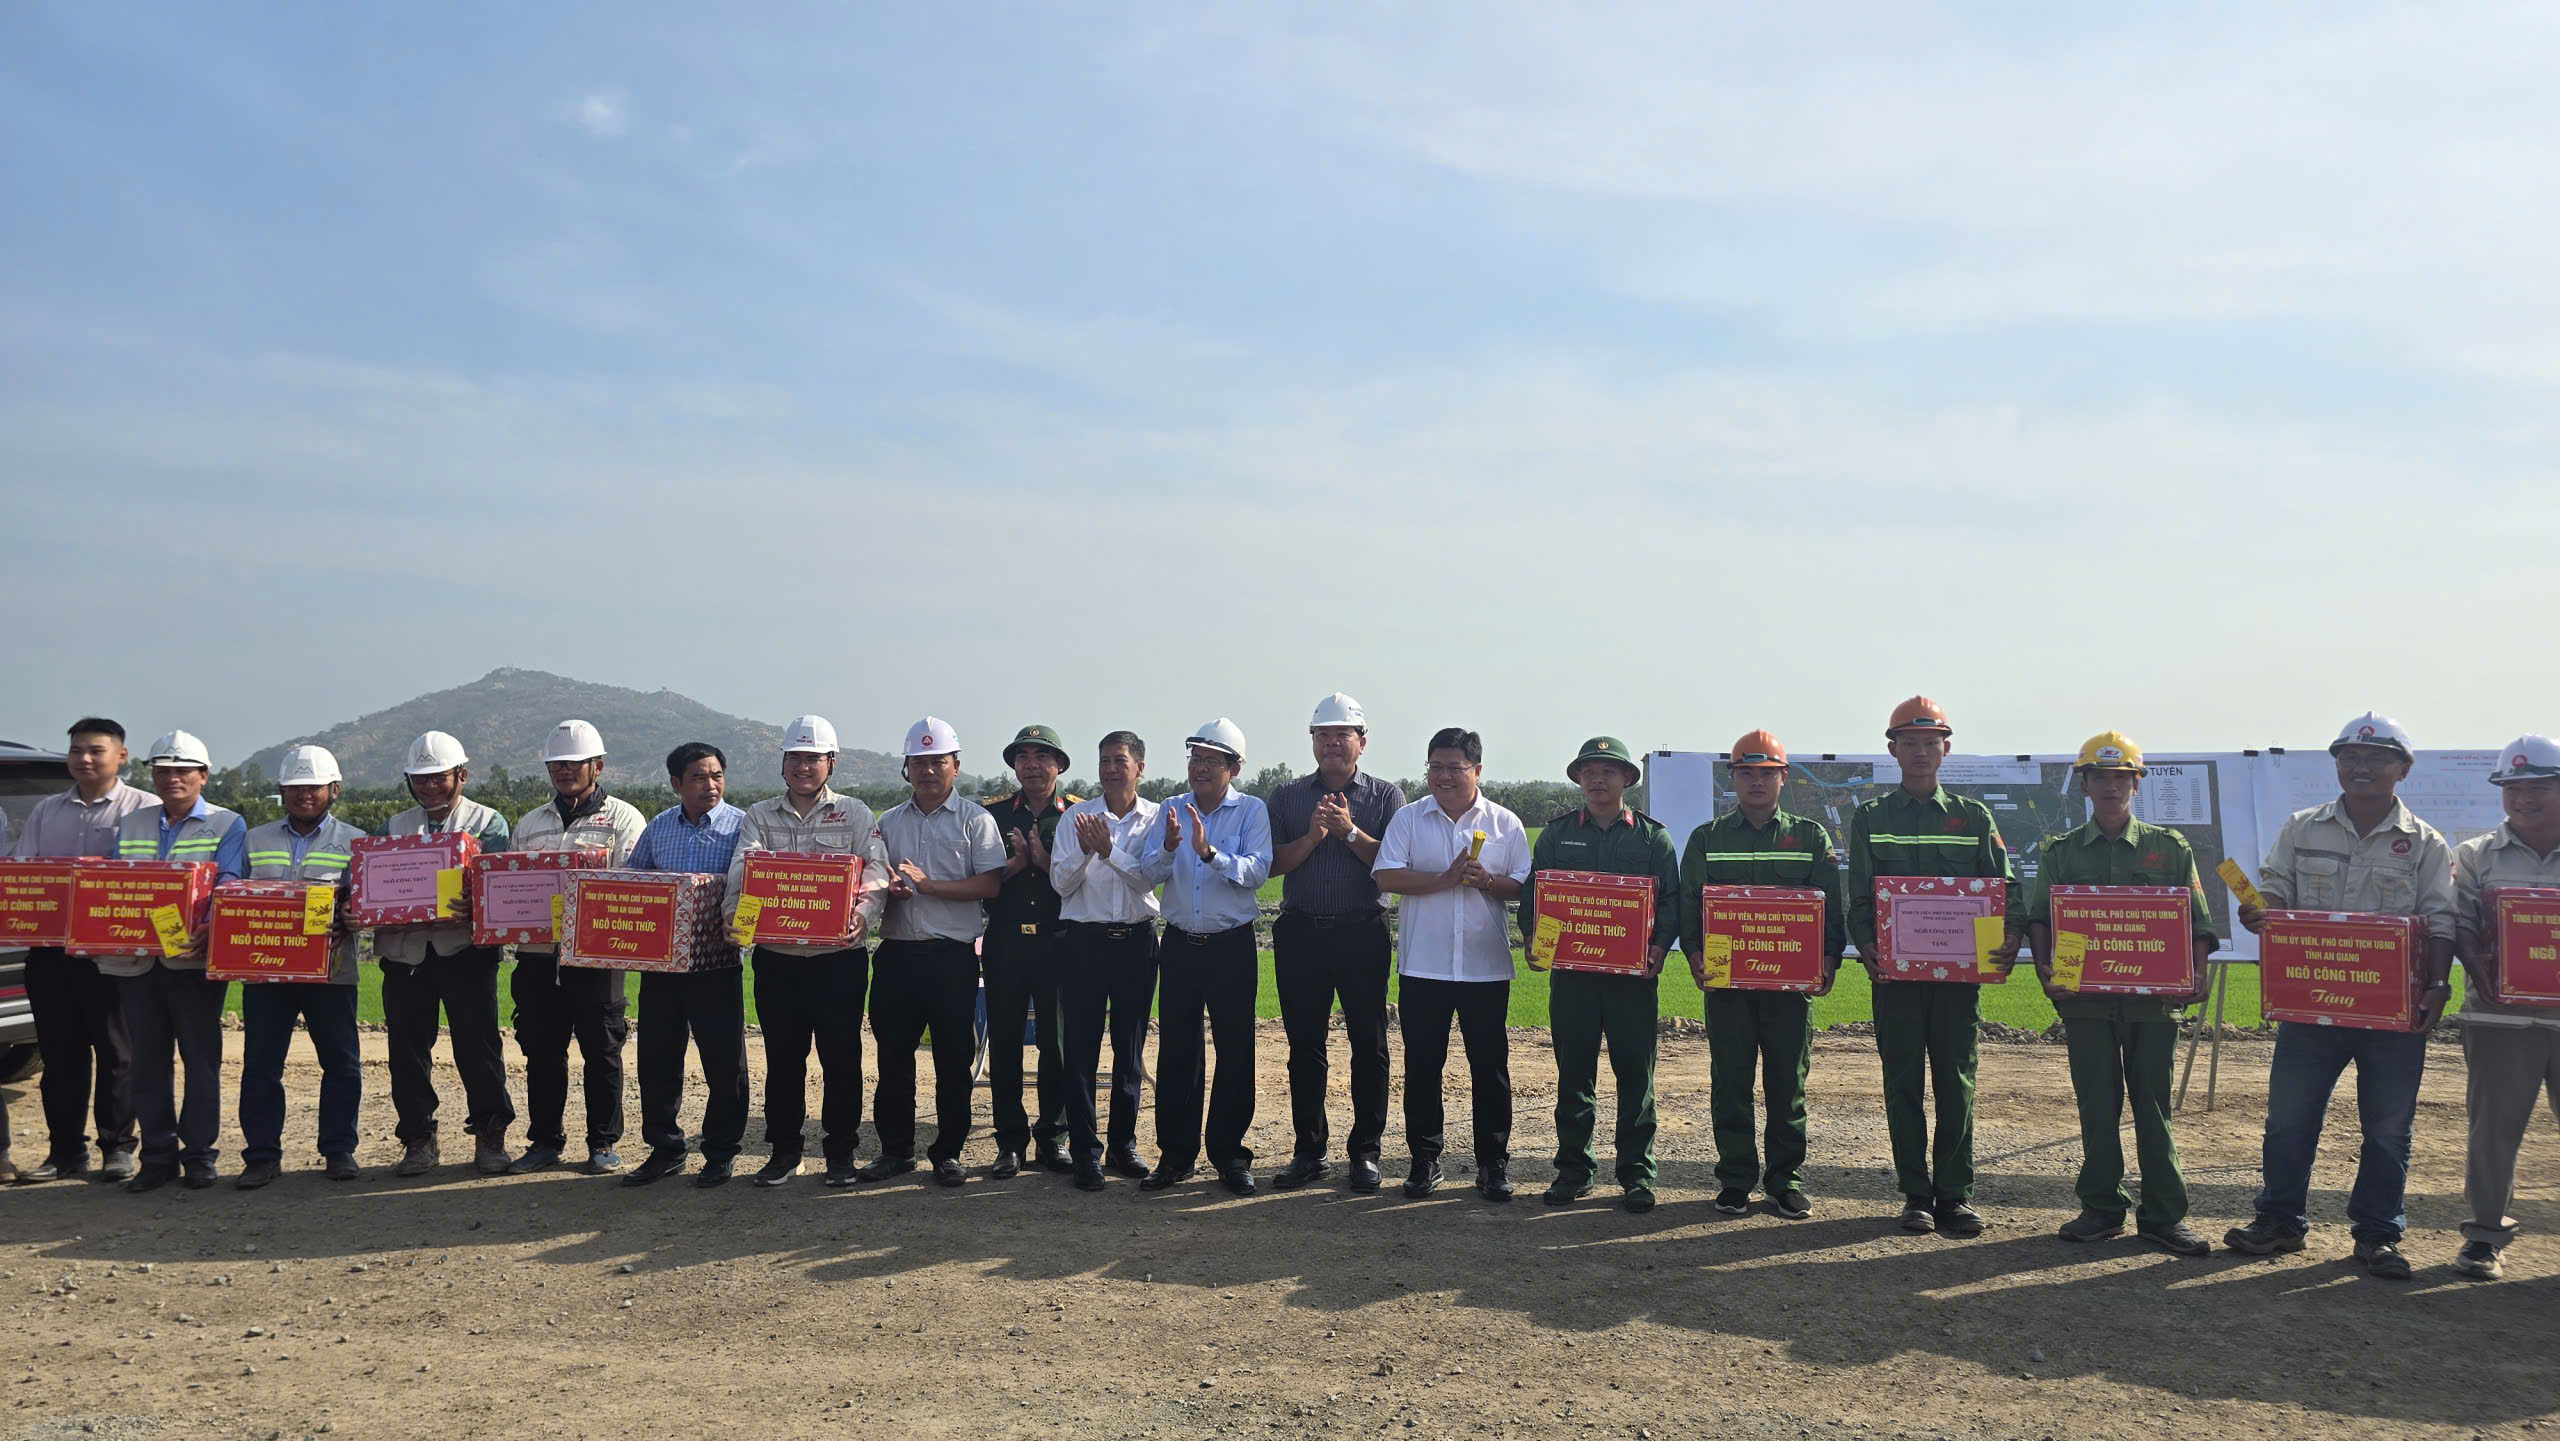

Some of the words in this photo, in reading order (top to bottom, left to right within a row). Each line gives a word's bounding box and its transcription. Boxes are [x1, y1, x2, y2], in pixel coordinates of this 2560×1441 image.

[777, 882, 790, 892] TỈNH
[790, 884, 799, 892] AN
[800, 884, 817, 893] GIANG
[0, 899, 8, 910] GÔ
[782, 897, 805, 909] CÔNG
[808, 898, 830, 910] THỨC
[1544, 892, 1557, 902] TỈNH
[1558, 893, 1566, 902] ỦY
[1567, 894, 1581, 904] VIÊN,
[1583, 895, 1595, 905] PHÓ
[1596, 896, 1607, 905] CHỦ
[1609, 898, 1621, 908] TỊCH
[1623, 900, 1639, 908] UBND
[89, 905, 111, 917] NGÔ
[113, 906, 140, 918] CÔNG
[1570, 906, 1583, 916] TỈNH
[1584, 908, 1593, 917] AN
[1594, 909, 1611, 918] GIANG
[1714, 910, 1727, 920] TỈNH
[1729, 910, 1736, 920] ỦY
[1738, 911, 1753, 921] VIÊN,
[1755, 912, 1767, 921] PHÓ
[1768, 912, 1780, 921] CHỦ
[1782, 914, 1795, 923] TỊCH
[1797, 914, 1814, 922] UBND
[2063, 908, 2078, 918] TỈNH
[2080, 908, 2089, 918] ỦY
[2091, 909, 2108, 919] VIÊN,
[2110, 909, 2123, 918] PHÓ
[2126, 908, 2140, 919] CHỦ
[2142, 911, 2157, 920] TỊCH
[2160, 911, 2178, 919] UBND
[593, 918, 610, 930] NGÔ
[612, 918, 633, 931] CÔNG
[636, 919, 656, 933] THỨC
[776, 916, 810, 930] Tặng
[1561, 920, 1572, 932] GÔ
[1575, 921, 1600, 935] CÔNG
[1603, 923, 1626, 937] THỨC
[1742, 923, 1755, 933] TỈNH
[1756, 925, 1766, 933] AN
[1767, 925, 1786, 934] GIANG
[2096, 921, 2110, 932] TỈNH
[2113, 924, 2123, 932] AN
[2124, 924, 2146, 932] GIANG
[108, 925, 146, 939] Tặng
[231, 934, 251, 945] NGÔ
[254, 934, 280, 946] CÔNG
[284, 935, 308, 947] THỨC
[608, 937, 639, 952] Tặng
[1733, 938, 1745, 950] GÔ
[1748, 938, 1774, 951] CÔNG
[1777, 939, 1802, 952] THỨC
[2087, 937, 2100, 951] GÔ
[2104, 938, 2134, 952] CÔNG
[2137, 938, 2165, 952] THỨC
[2272, 933, 2288, 944] TỈNH
[2290, 933, 2299, 944] ỦY
[2300, 936, 2320, 947] VIÊN,
[2321, 937, 2336, 947] PHÓ
[2338, 937, 2354, 948] CHỦ
[2355, 939, 2372, 950] TỊCH
[2374, 940, 2395, 950] UBND
[1571, 942, 1606, 957] Tặng
[2305, 948, 2322, 960] TỈNH
[2324, 951, 2335, 961] AN
[2336, 952, 2360, 962] GIANG
[2529, 945, 2557, 960] NGÔ
[250, 952, 285, 967] Tặng
[1745, 958, 1782, 974] Tặng
[2101, 960, 2143, 976] Tặng
[2286, 965, 2309, 979] NGÔ
[2314, 967, 2346, 982] CÔNG
[2350, 968, 2380, 984] THỨC
[2310, 989, 2355, 1008] Tặng
